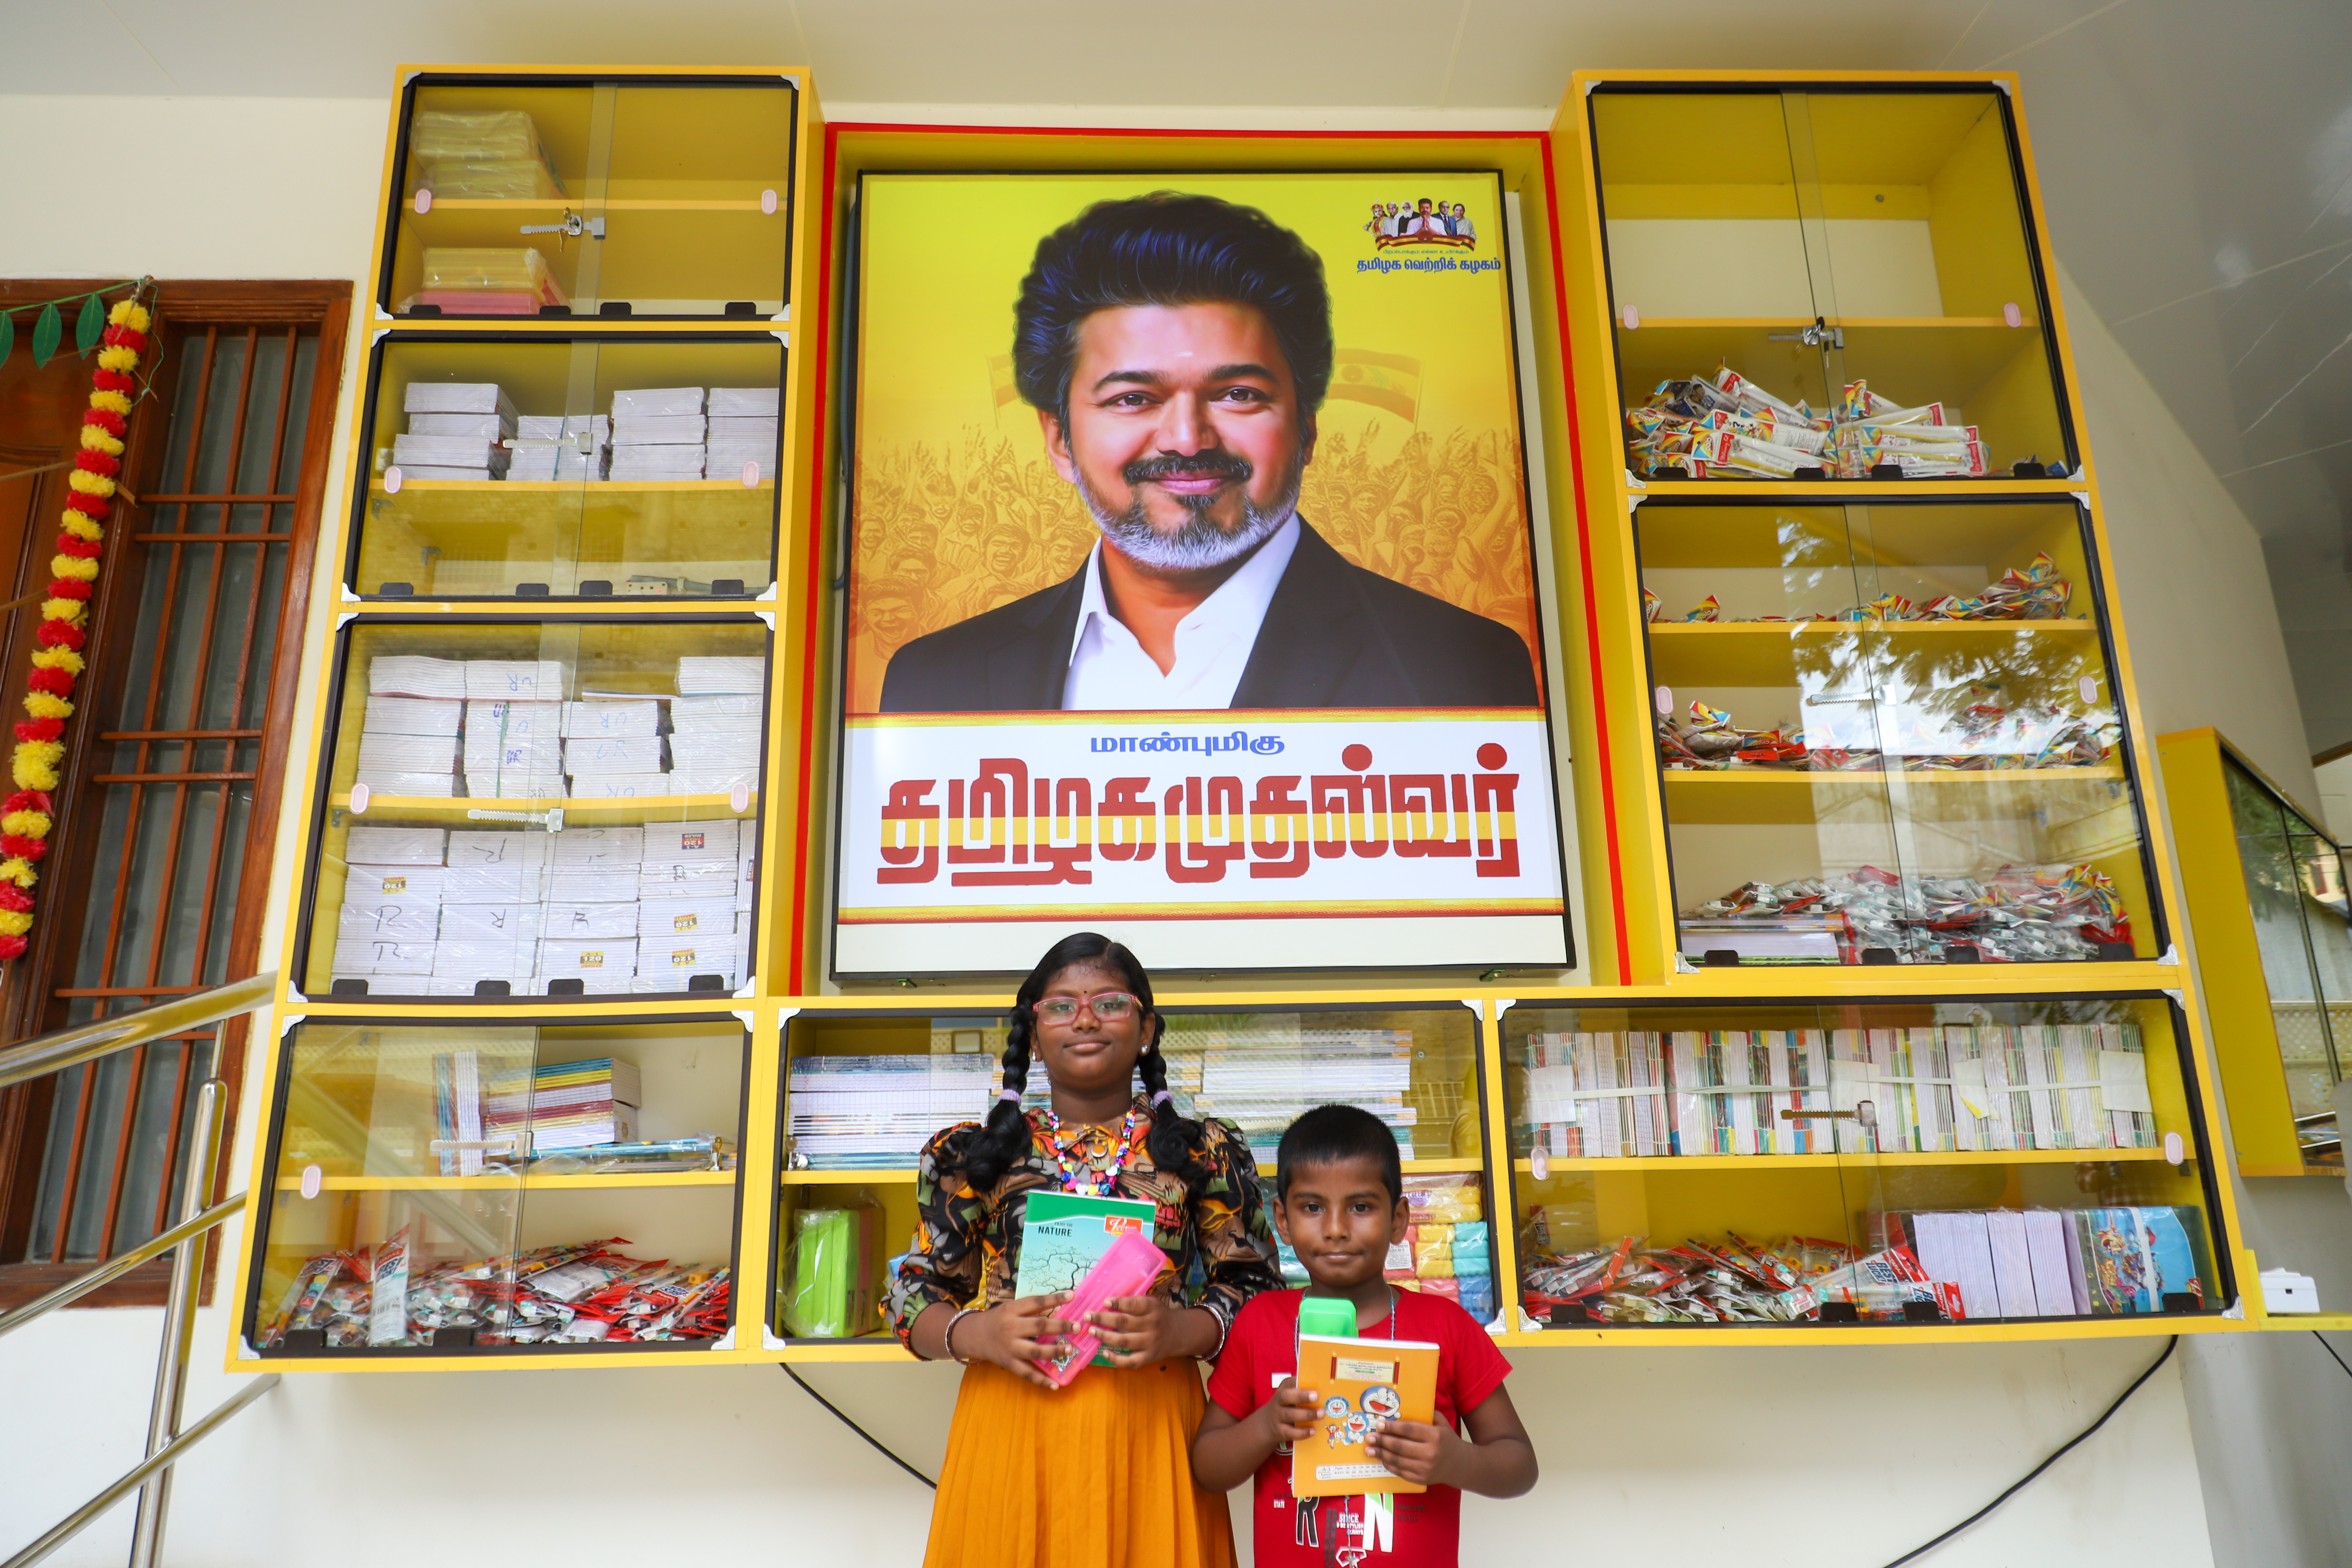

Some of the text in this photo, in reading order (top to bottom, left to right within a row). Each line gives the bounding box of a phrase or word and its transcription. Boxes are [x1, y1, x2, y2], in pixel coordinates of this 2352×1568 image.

[1357, 257, 1501, 274] தமிழக வெற்றிக் கழகம்
[1090, 731, 1285, 756] மாண்புமிகு
[1038, 1226, 1072, 1237] NATURE
[1865, 1262, 1886, 1282] LUCK!
[1876, 1262, 1898, 1284] BEST
[1885, 1252, 1904, 1276] NATARAJ
[1274, 1500, 1285, 1508] STATE
